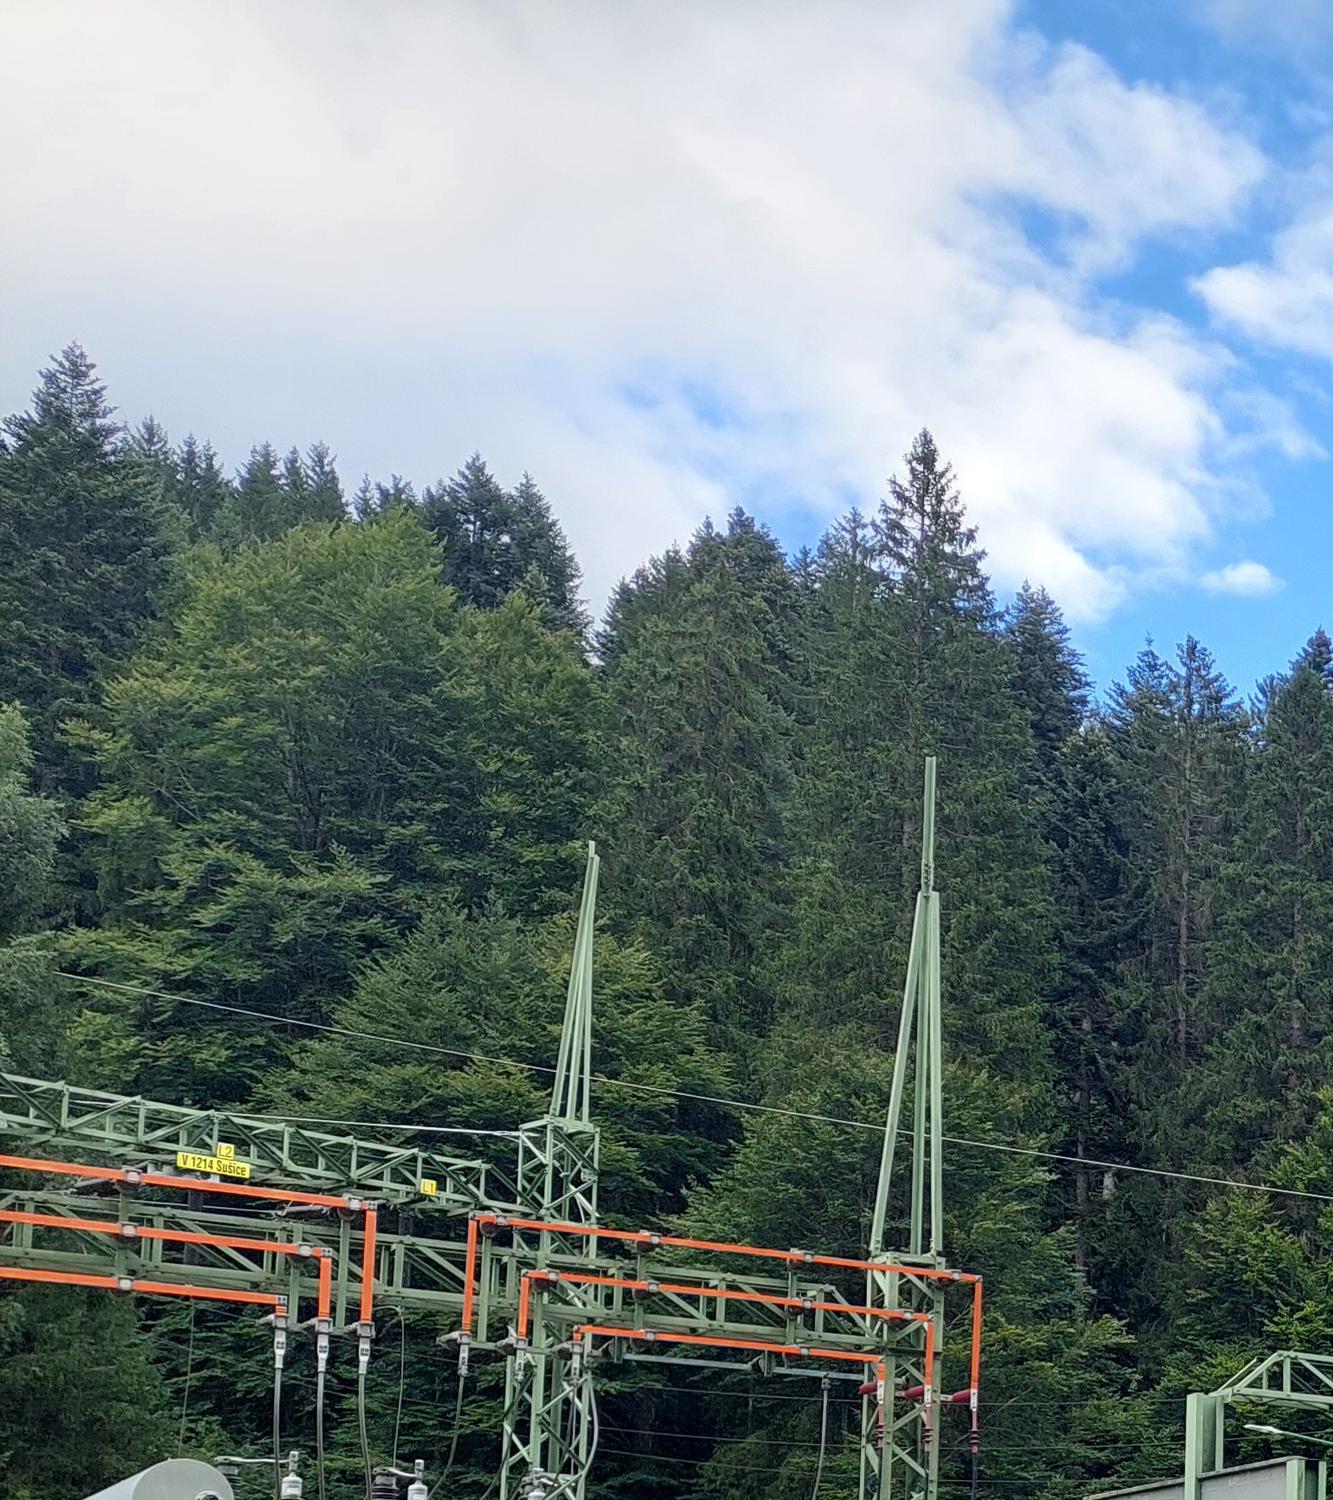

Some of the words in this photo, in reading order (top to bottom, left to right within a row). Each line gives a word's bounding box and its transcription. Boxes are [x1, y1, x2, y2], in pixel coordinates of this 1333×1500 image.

[218, 1145, 232, 1158] L2
[181, 1154, 188, 1166] V
[191, 1157, 214, 1170] 1214
[216, 1160, 247, 1176] Sušice
